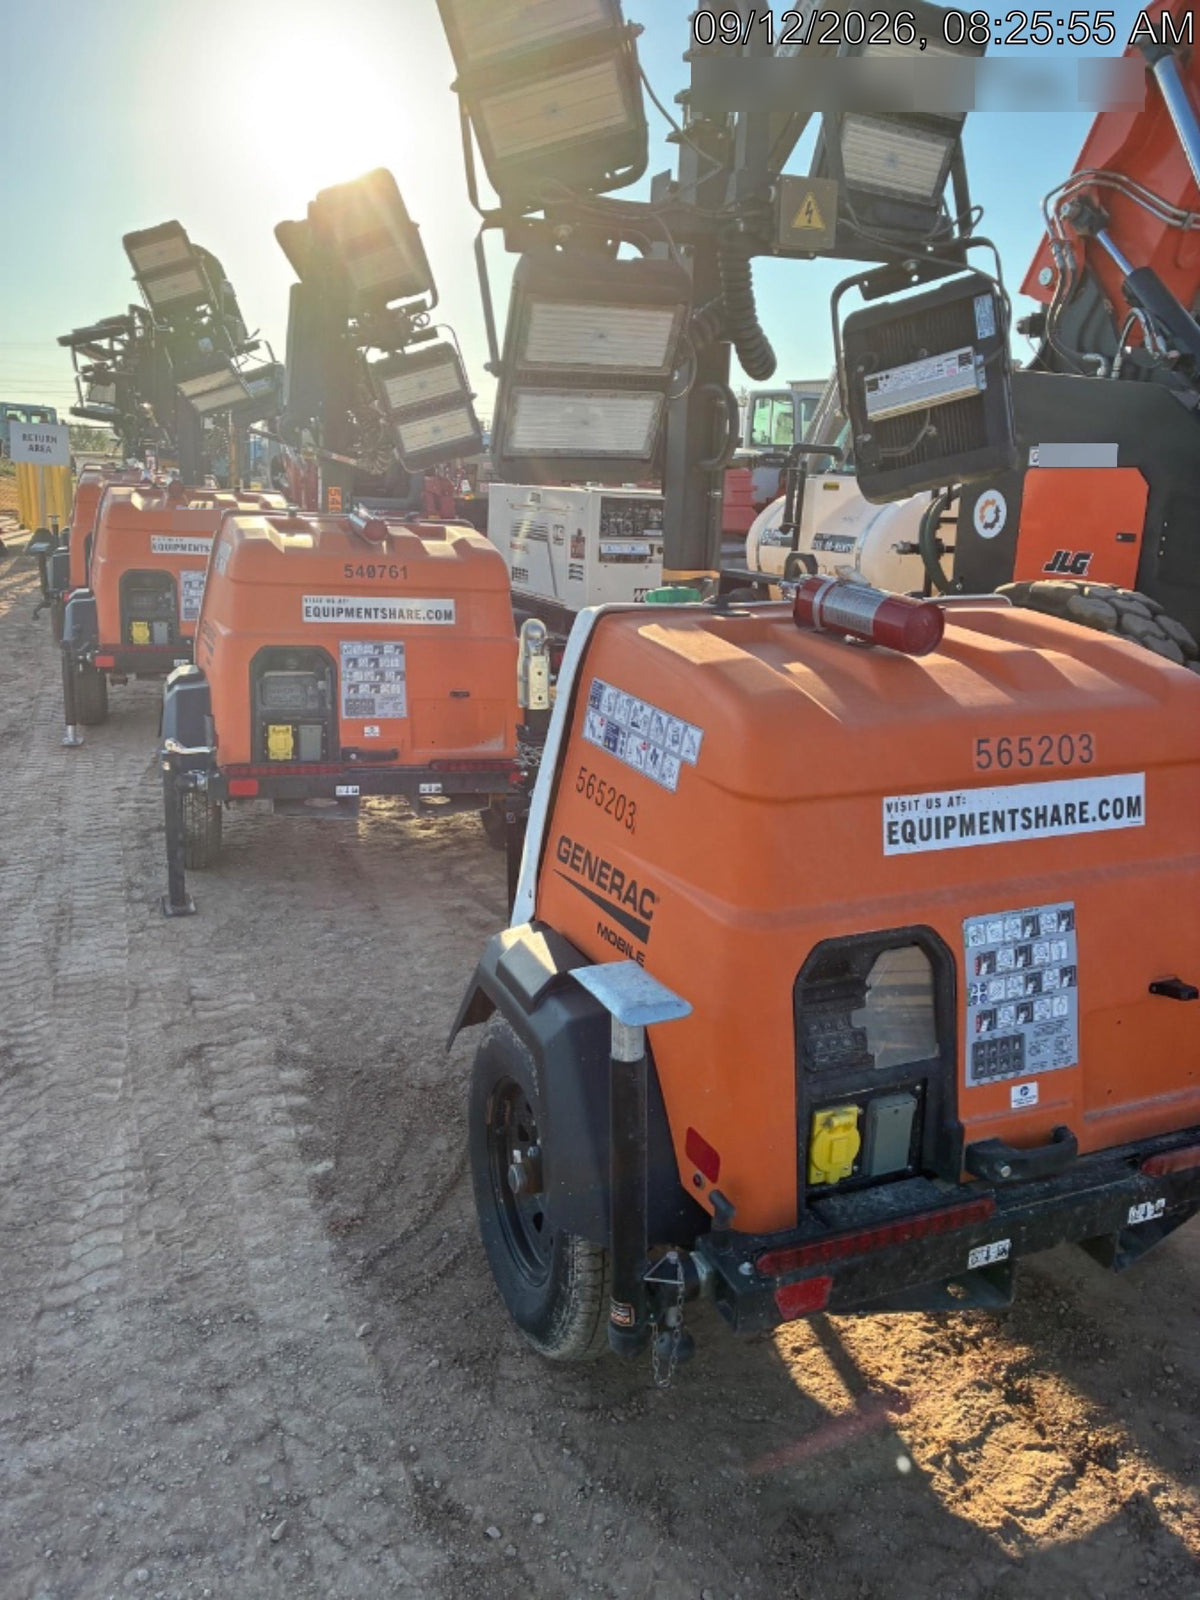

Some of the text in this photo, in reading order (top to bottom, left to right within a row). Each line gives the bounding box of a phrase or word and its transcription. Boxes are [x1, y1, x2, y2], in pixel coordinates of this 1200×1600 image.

[22, 433, 57, 444] RETURN
[28, 444, 52, 453] AREA
[344, 565, 408, 579] 540761
[1042, 549, 1094, 576] JLG
[305, 605, 453, 621] EQUIPMENTSHARE.COM
[976, 733, 1094, 769] 565203
[886, 795, 967, 814] VISIT US AT:
[886, 794, 1142, 846] EQUIPMENTSHARE.COM
[556, 835, 655, 921] GENERAC
[596, 921, 646, 969] MOBILE
